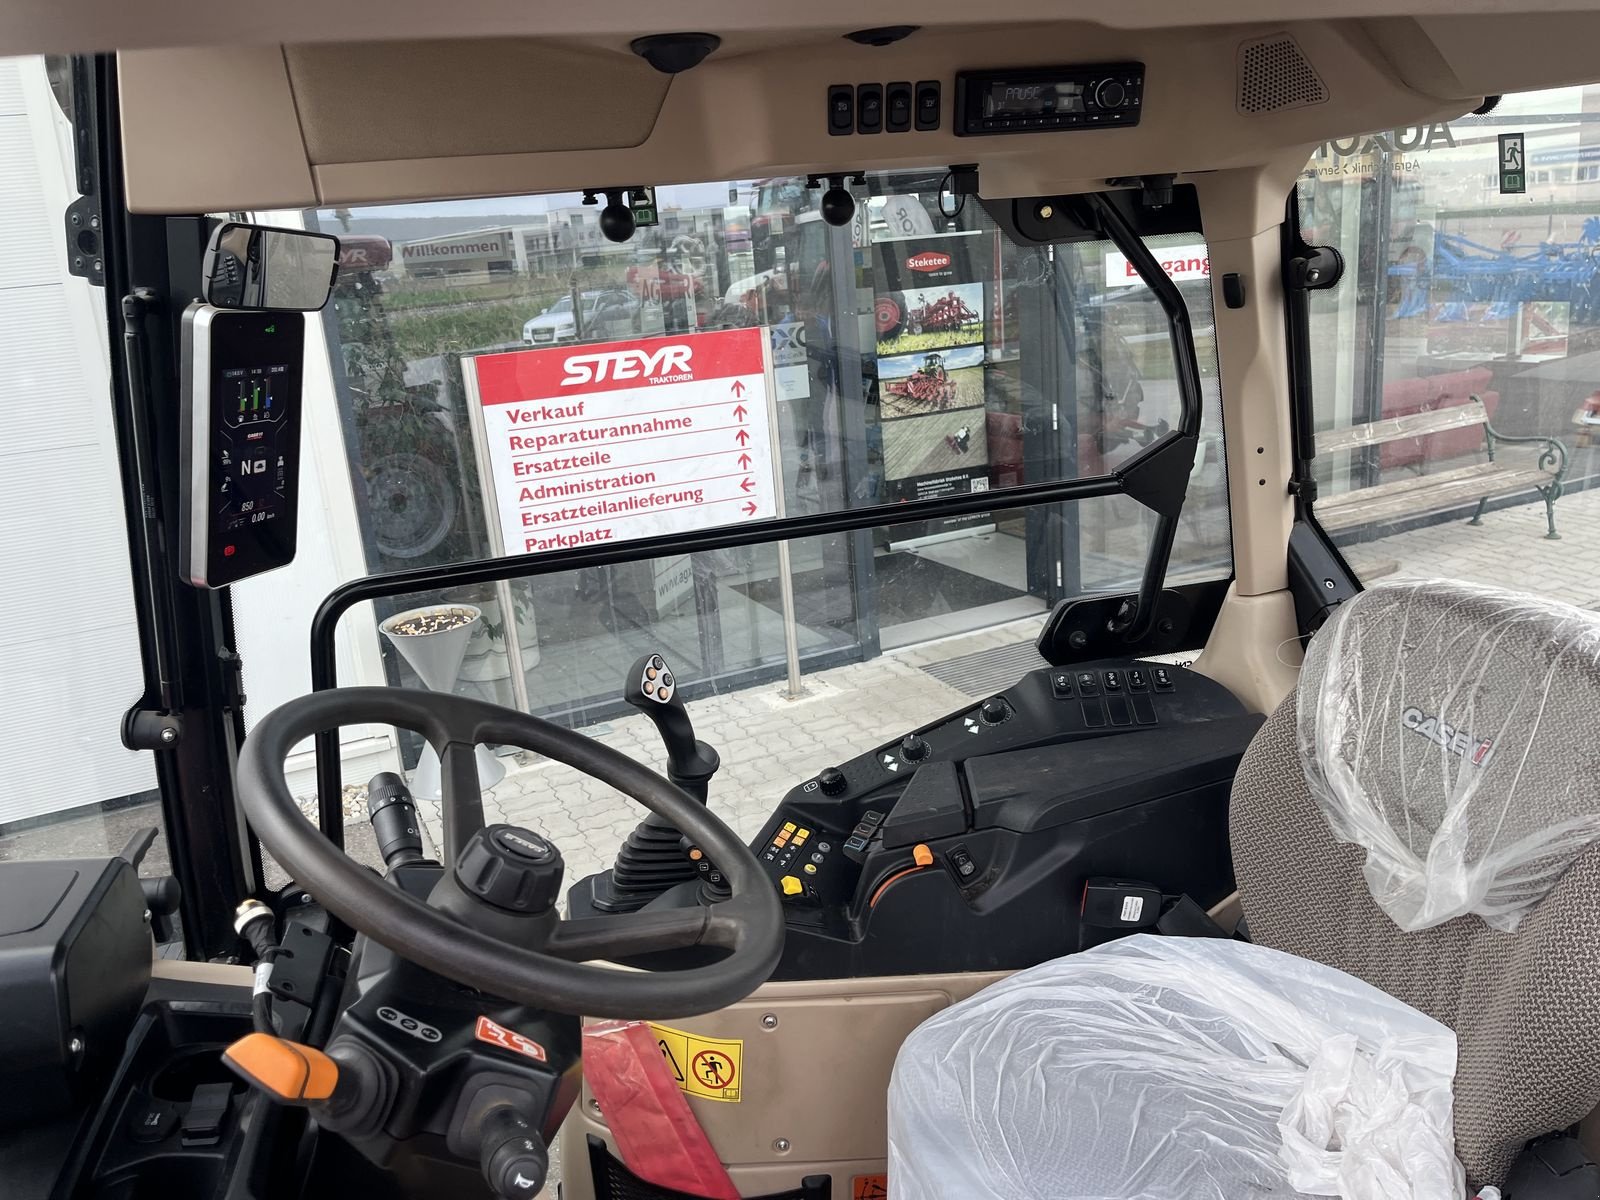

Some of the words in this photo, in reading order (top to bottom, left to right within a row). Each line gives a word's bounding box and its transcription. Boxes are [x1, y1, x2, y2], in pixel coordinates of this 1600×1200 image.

[402, 242, 499, 258] Willkommen
[908, 257, 948, 268] Steketee
[1125, 257, 1210, 278] Egang
[560, 344, 694, 386] STEYR
[649, 373, 694, 385] TRAKTOREN
[506, 402, 585, 425] Verkauf
[509, 414, 693, 451] Reparaturannahme
[241, 459, 251, 476] N
[513, 451, 611, 477] Ersatzteile
[519, 470, 656, 502] Administration
[241, 501, 254, 512] 850
[251, 512, 266, 523] 0.00
[521, 488, 704, 527] Ersatzteilanlieferung
[525, 527, 613, 552] Parkplatz
[1402, 707, 1466, 757] CASE
